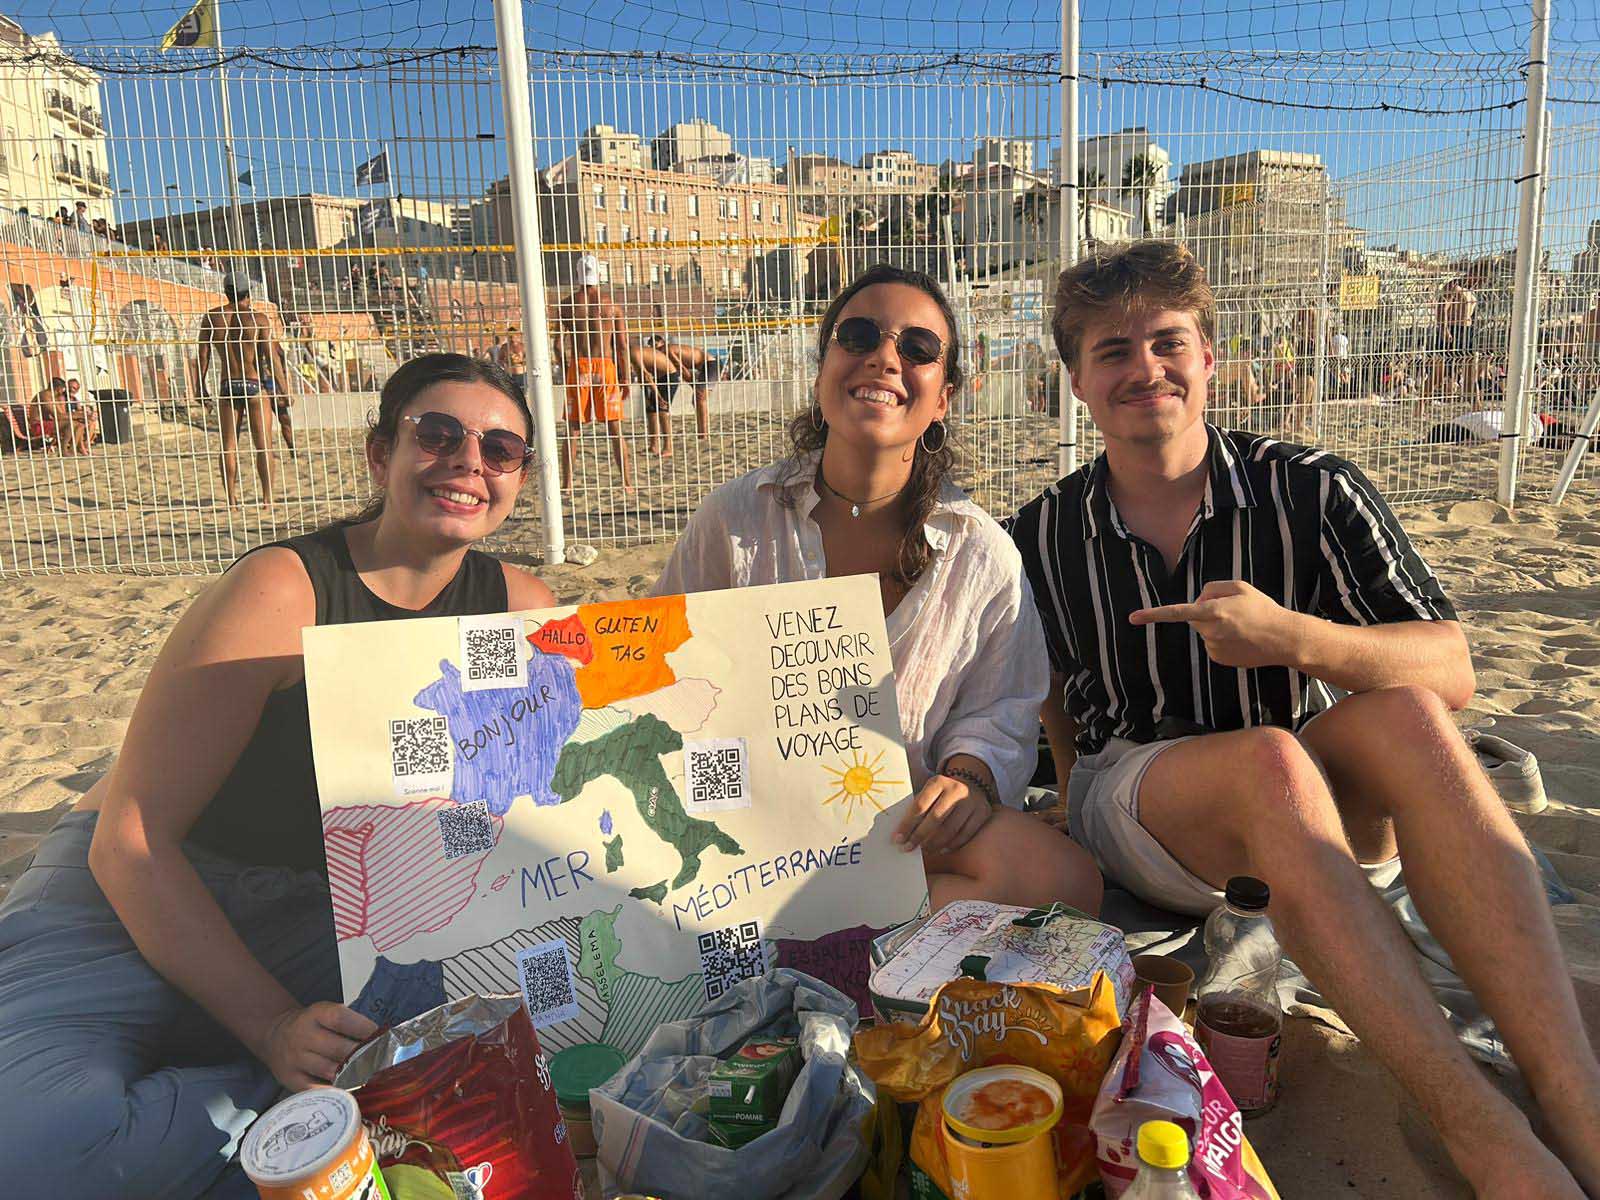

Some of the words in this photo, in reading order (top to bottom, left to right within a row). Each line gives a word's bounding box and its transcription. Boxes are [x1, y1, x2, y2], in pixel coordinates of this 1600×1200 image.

[542, 629, 586, 646] HALLO
[594, 616, 659, 634] GUTEN
[765, 606, 843, 639] VENEZ
[611, 645, 646, 662] TAG
[771, 632, 874, 669] DECOUVRIR
[771, 672, 808, 700] DES
[817, 662, 872, 695] BONS
[775, 698, 843, 728] PLANS
[854, 691, 881, 718] DE
[776, 725, 862, 761] VOYAGE
[520, 850, 594, 908] MER
[588, 928, 610, 998] ASSELEMA
[735, 1112, 763, 1121] POMME
